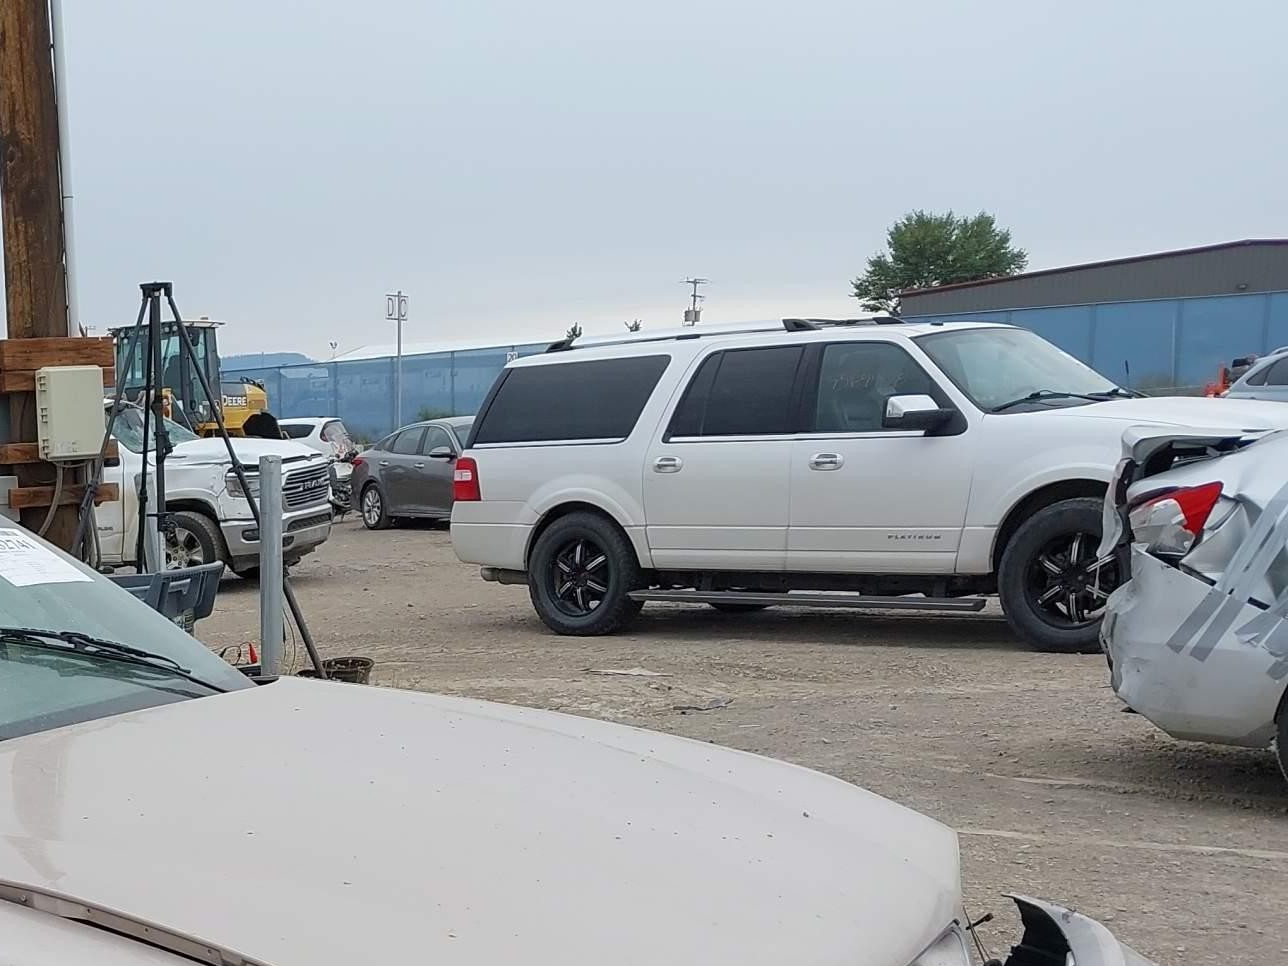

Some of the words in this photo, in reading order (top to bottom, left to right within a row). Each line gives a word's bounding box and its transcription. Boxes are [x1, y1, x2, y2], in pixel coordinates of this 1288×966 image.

[387, 297, 395, 317] D
[221, 395, 247, 406] DEERE
[304, 479, 325, 489] RAM
